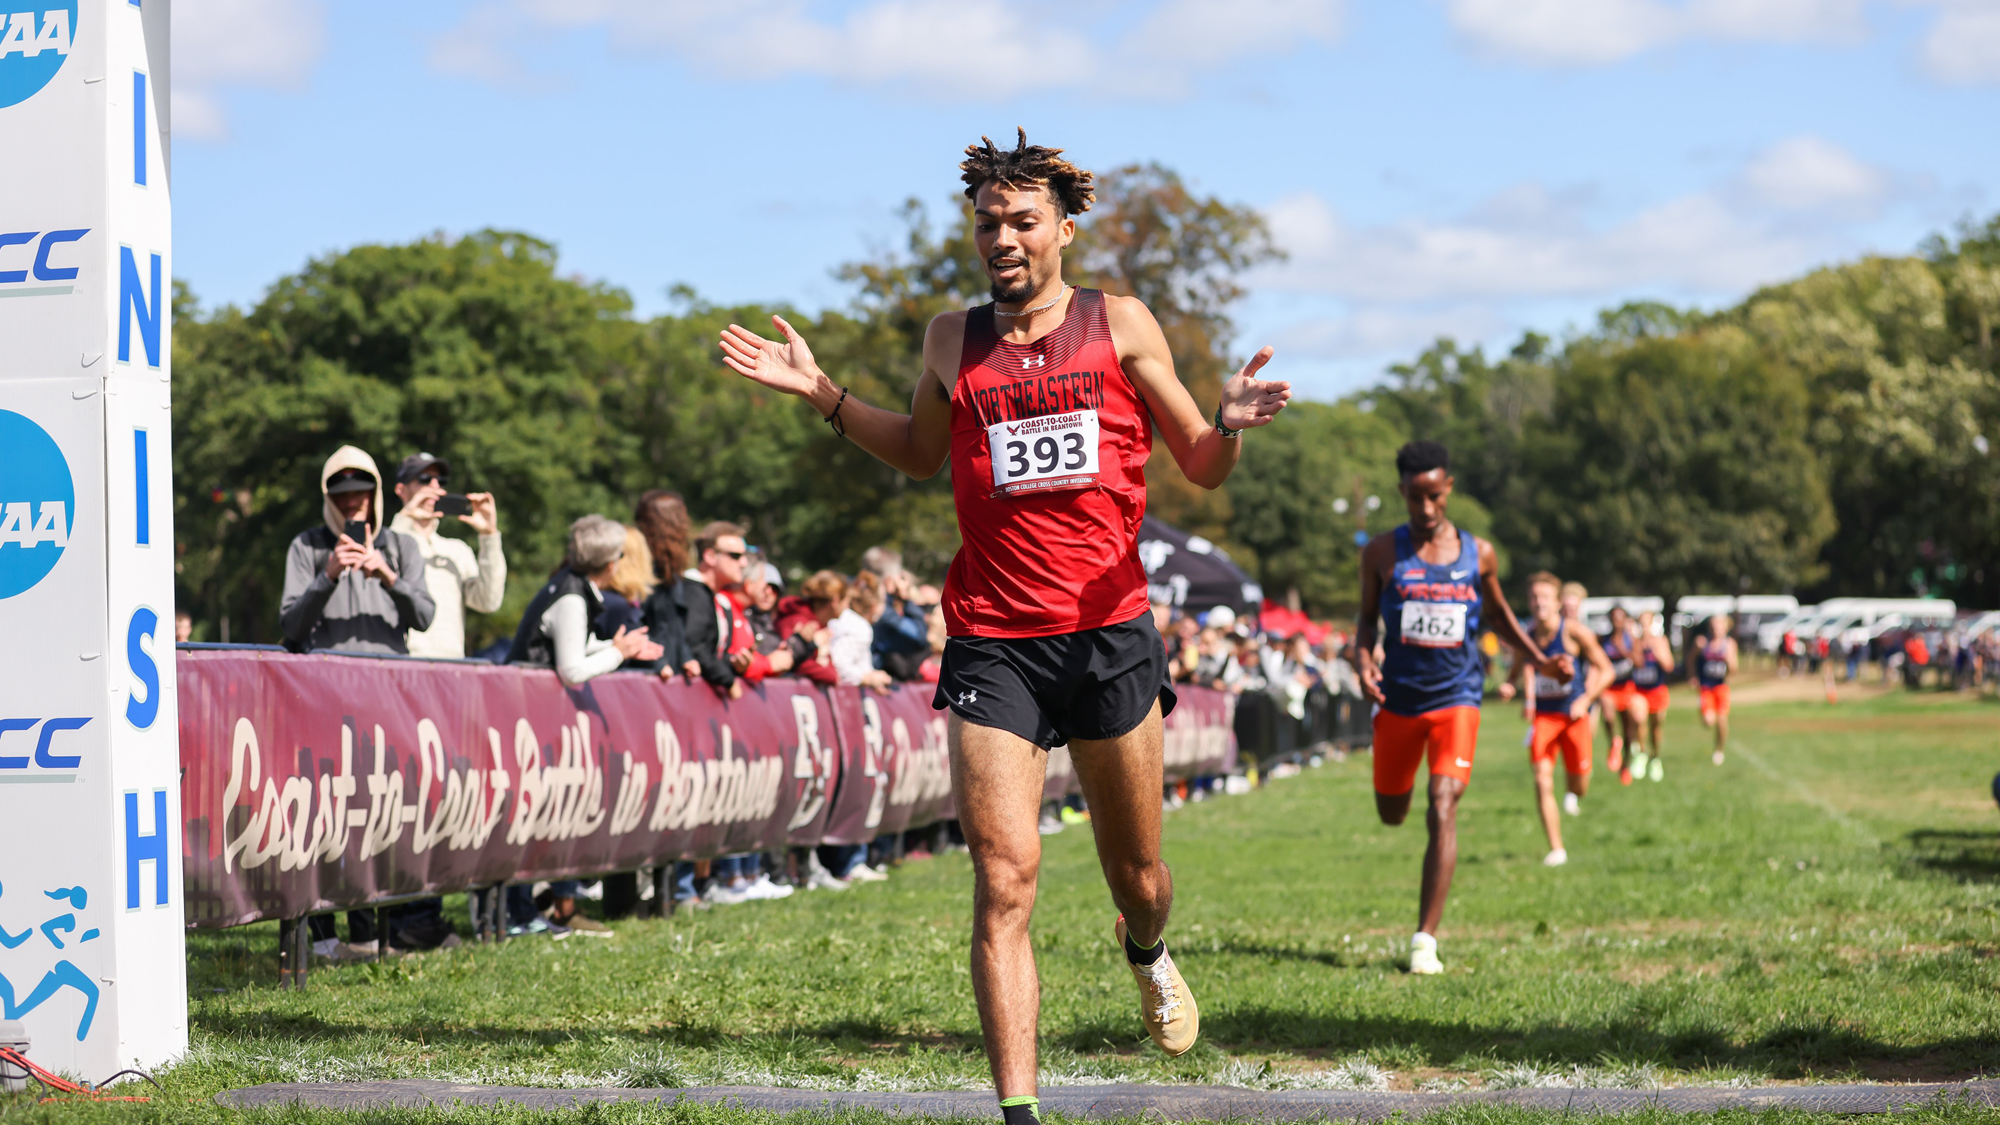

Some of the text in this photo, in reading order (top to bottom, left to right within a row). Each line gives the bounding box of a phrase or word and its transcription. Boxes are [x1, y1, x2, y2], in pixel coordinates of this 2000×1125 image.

[969, 371, 1105, 428] NORTHEASTERN
[1021, 413, 1082, 429] COAST-TO-COAST
[1021, 421, 1083, 436] BATTLE IN BEANTOWN
[1006, 432, 1087, 478] 393
[1020, 482, 1037, 490] COLLEGE
[1038, 480, 1051, 488] CROSS
[1051, 478, 1069, 487] COUNTRY
[1070, 476, 1093, 485] INVITATIONAL
[1395, 582, 1478, 602] VIRGINIA
[1410, 615, 1455, 637] 462
[223, 717, 510, 874] Coast-to-Coast
[506, 710, 607, 846] Battle
[609, 750, 649, 836] in
[648, 719, 784, 832] Beantown
